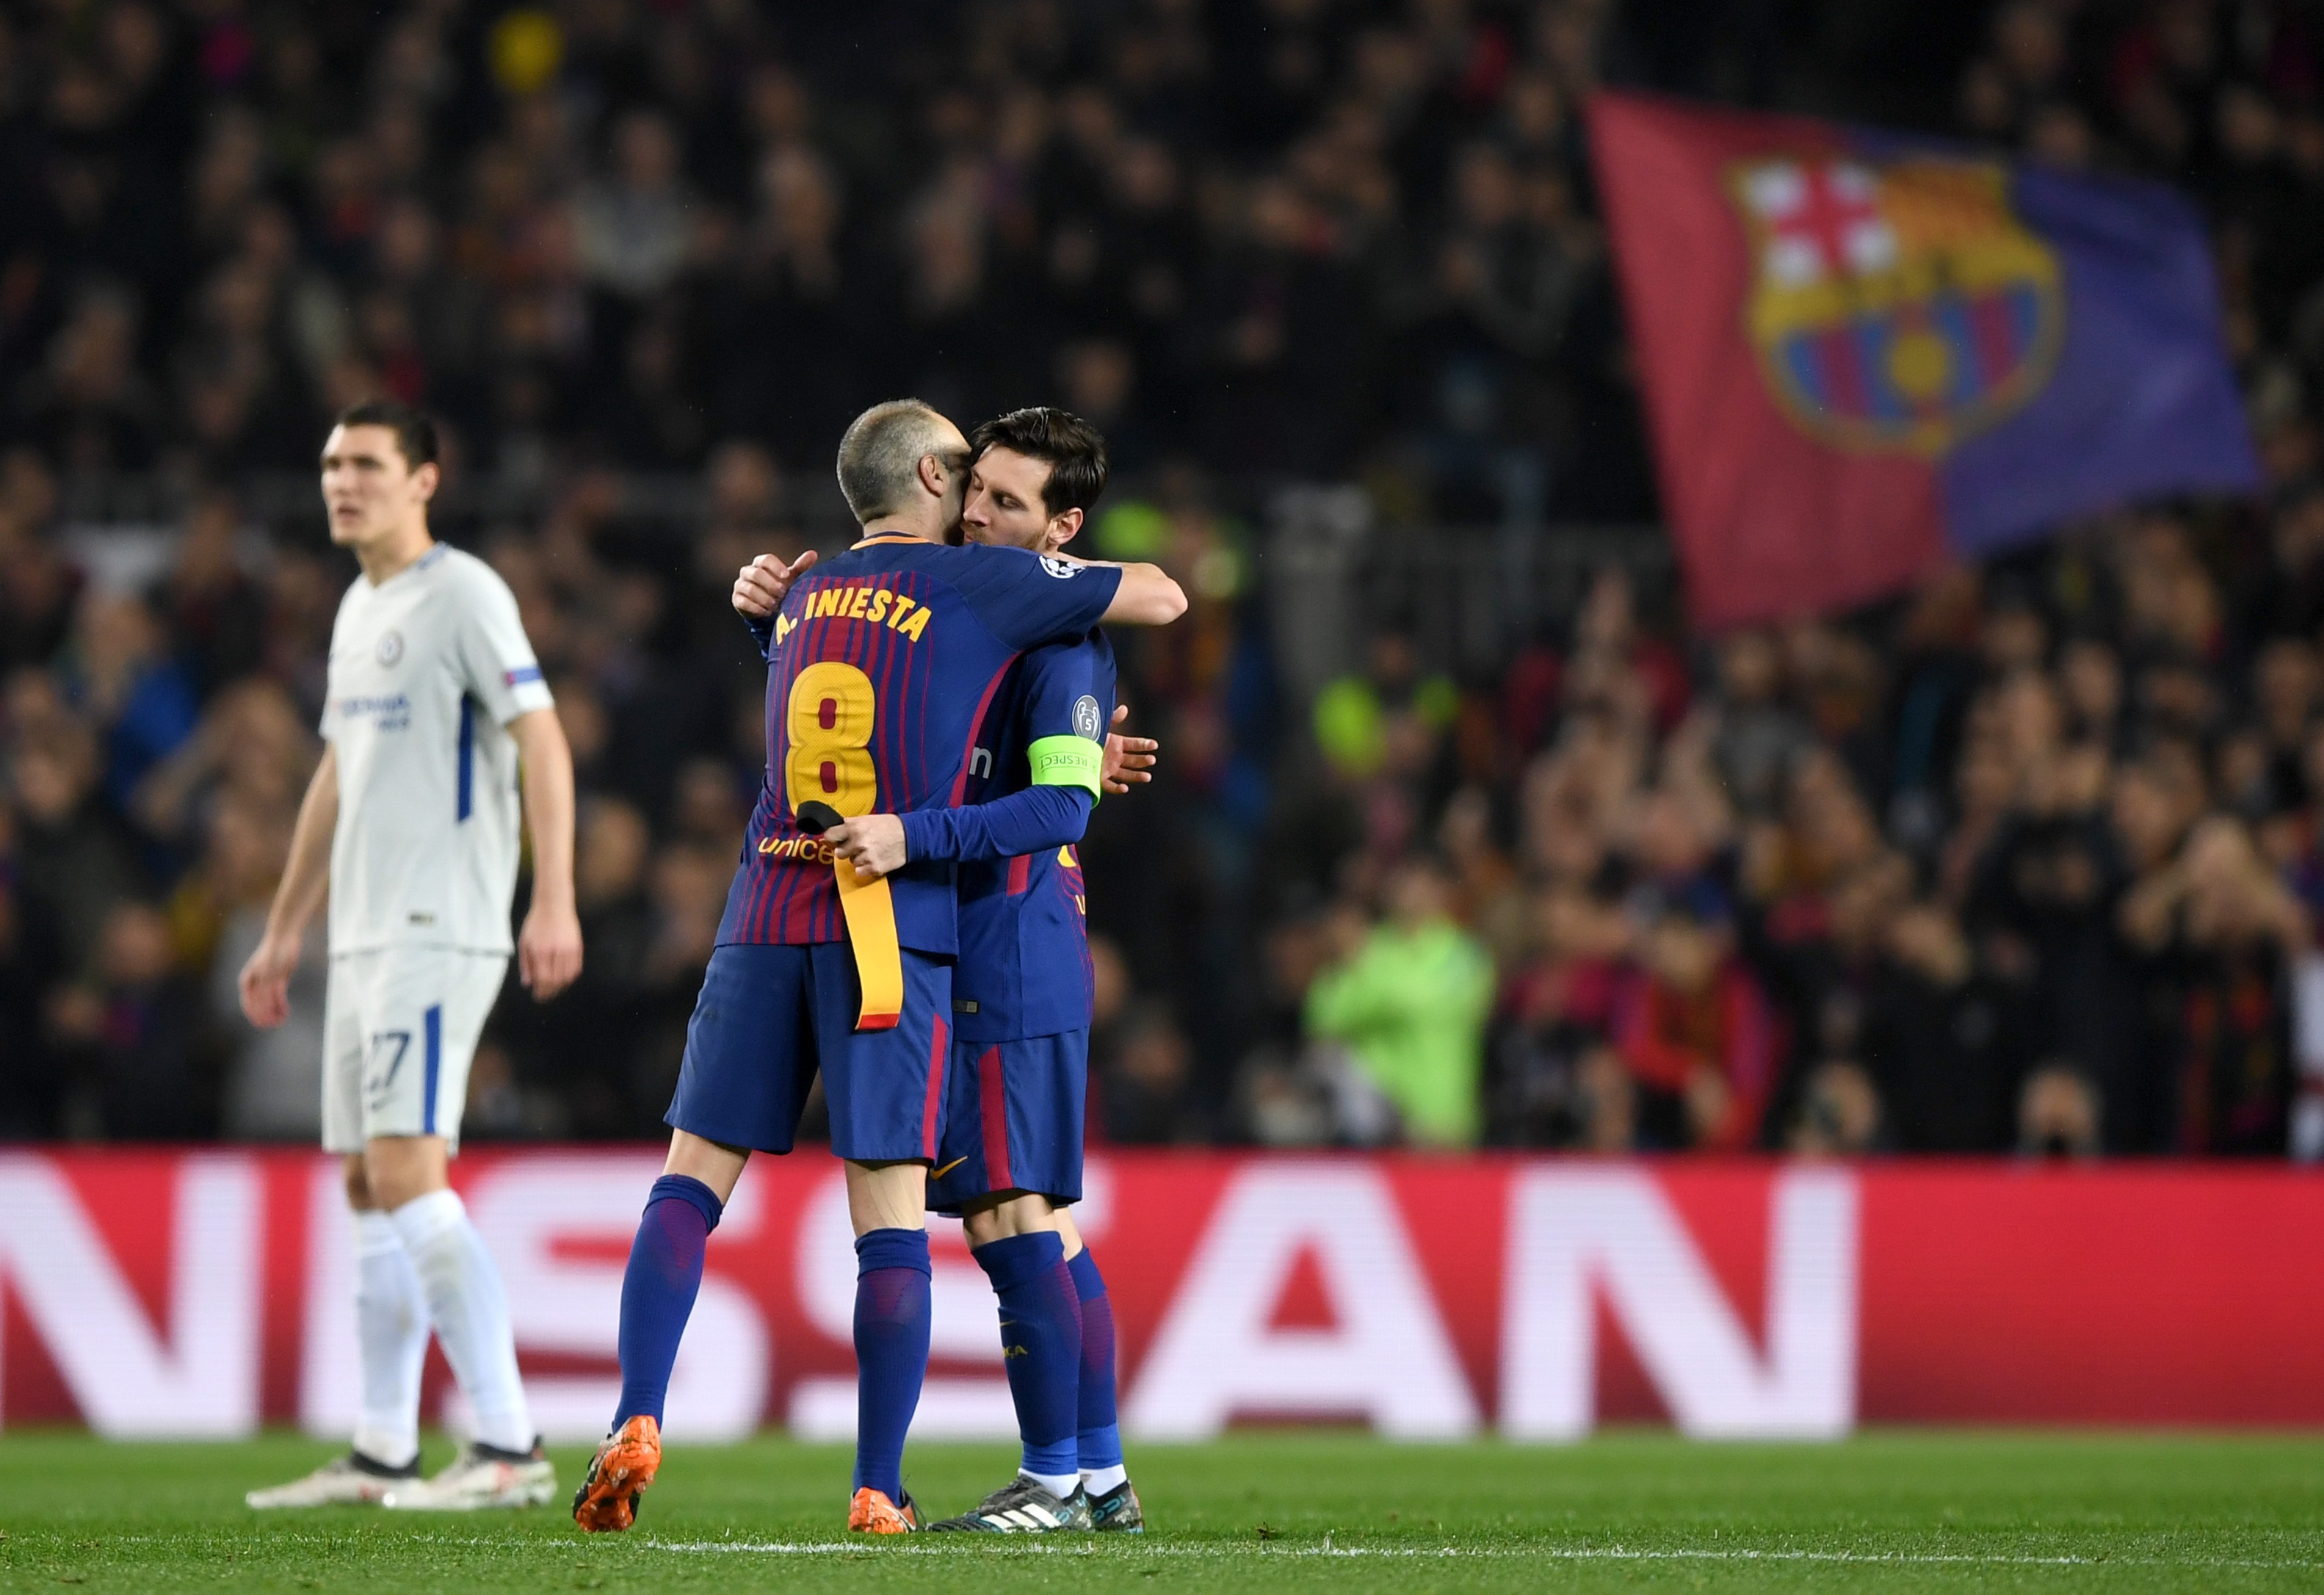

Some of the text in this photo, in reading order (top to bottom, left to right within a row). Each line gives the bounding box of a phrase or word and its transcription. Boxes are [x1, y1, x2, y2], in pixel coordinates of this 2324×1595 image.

[775, 587, 932, 646] A. INIESTA
[785, 661, 877, 818] 8
[1085, 717, 1093, 731] 5
[1040, 755, 1087, 770] RESPECT
[758, 833, 834, 865] unice
